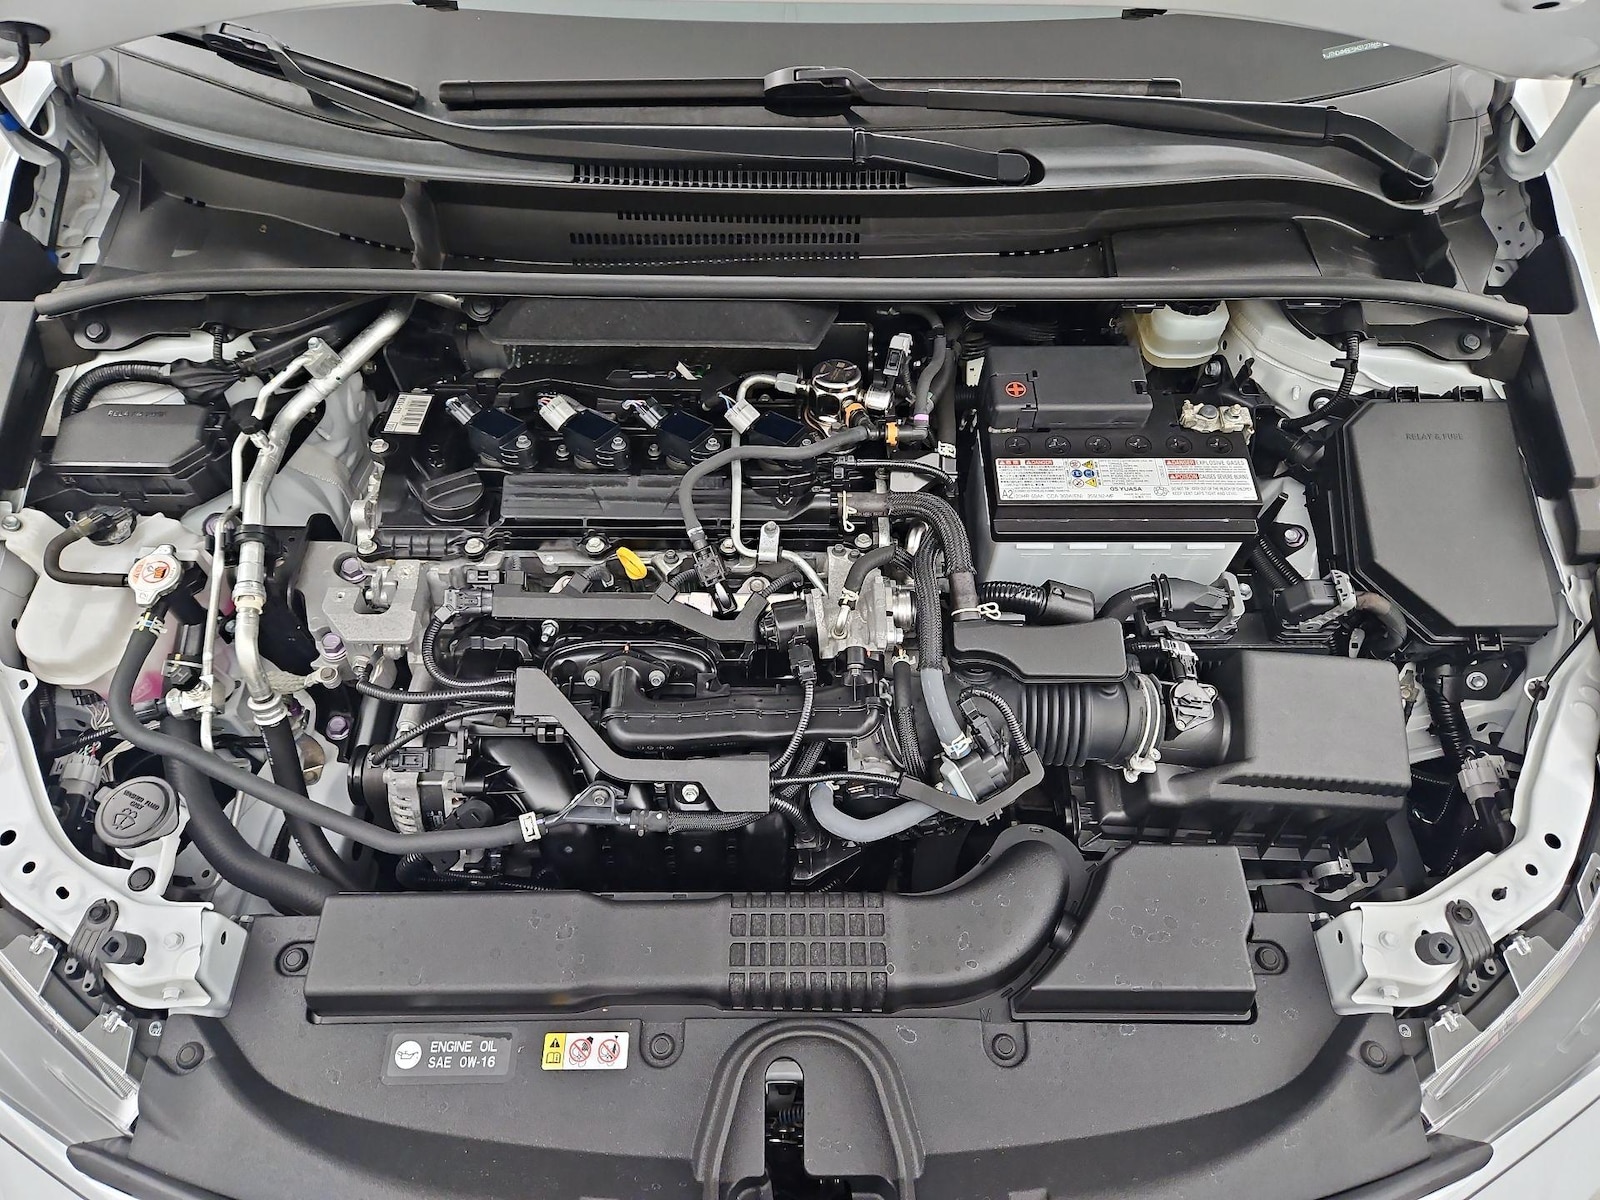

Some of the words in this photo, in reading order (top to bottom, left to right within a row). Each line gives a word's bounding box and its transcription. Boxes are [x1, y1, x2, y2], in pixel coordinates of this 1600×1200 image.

[1405, 432, 1432, 441] RELAY
[1434, 433, 1441, 441] &
[1442, 432, 1464, 441] FUSE
[1002, 489, 1014, 499] A2
[429, 1040, 472, 1053] ENGINE
[479, 1040, 498, 1053] OIL
[427, 1056, 452, 1068] SAE
[459, 1055, 496, 1068] 0W-16
